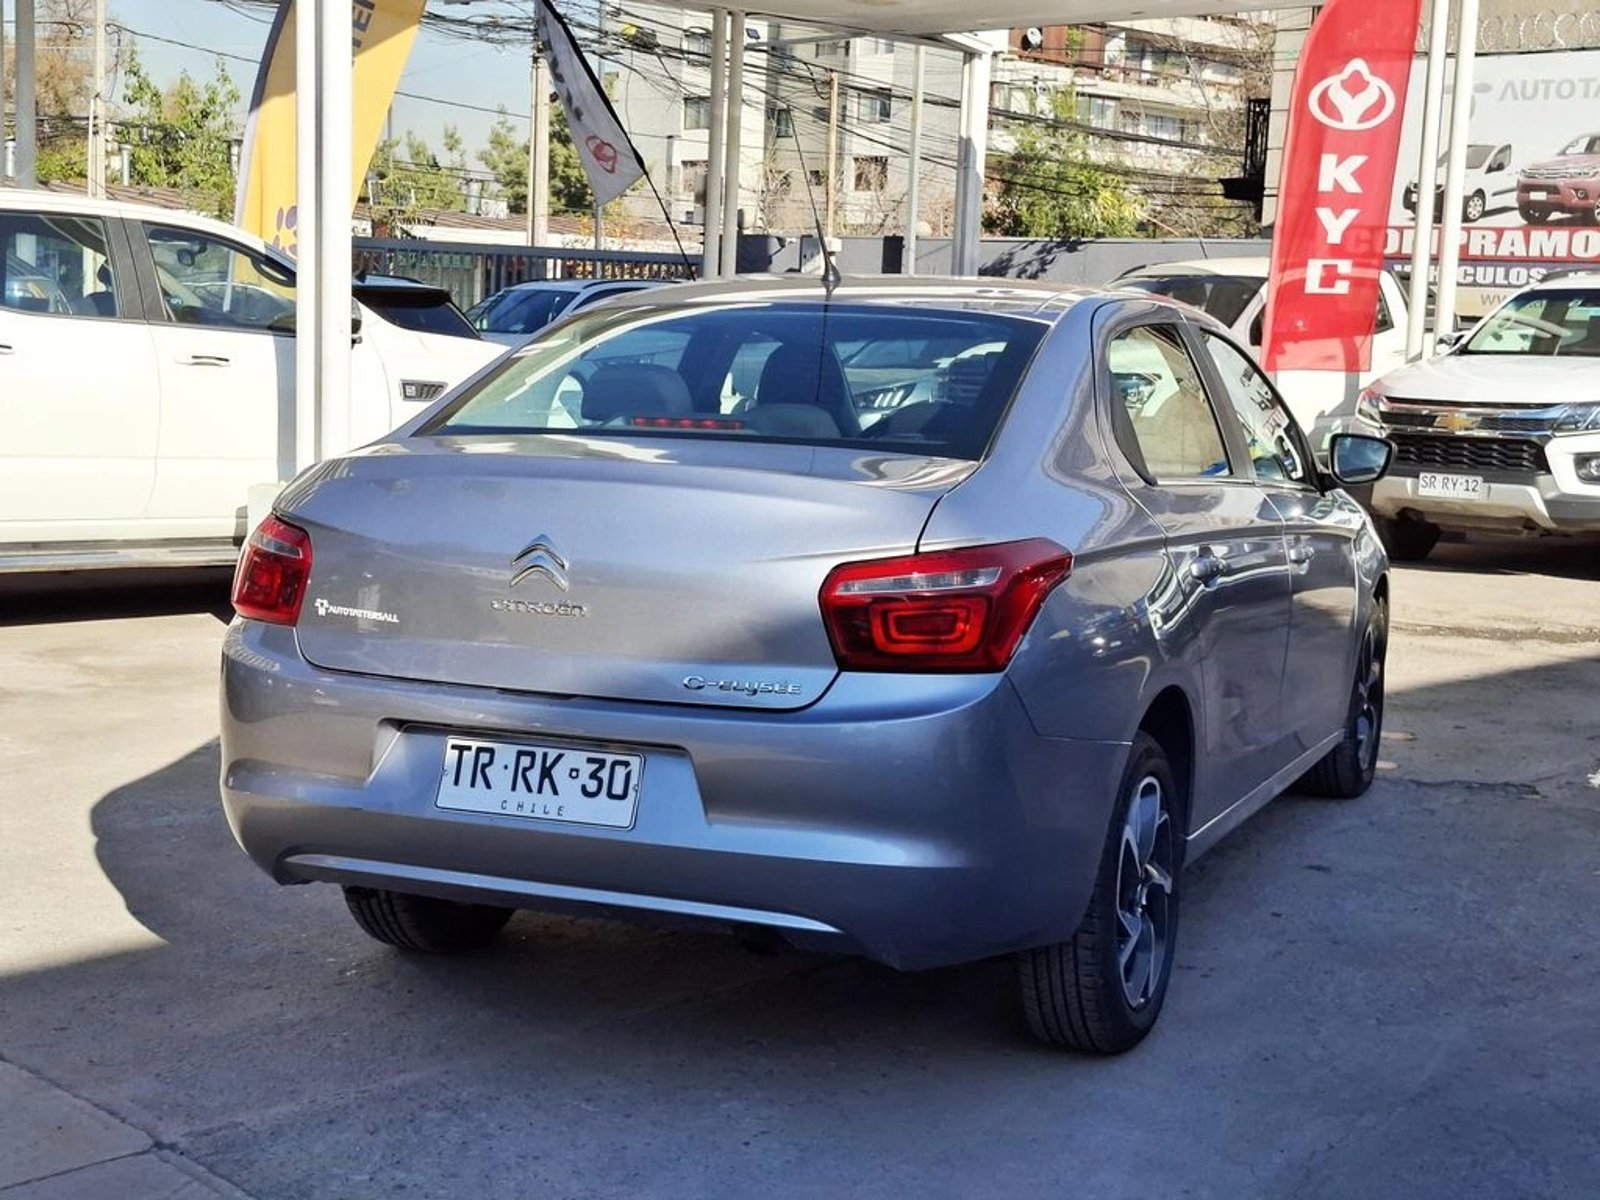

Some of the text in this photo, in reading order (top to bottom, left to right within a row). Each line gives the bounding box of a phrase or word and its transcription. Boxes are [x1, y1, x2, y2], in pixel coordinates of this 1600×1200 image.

[1500, 78, 1600, 100] AUTOT
[1304, 153, 1369, 294] KYC
[500, 799, 566, 817] CHILE
